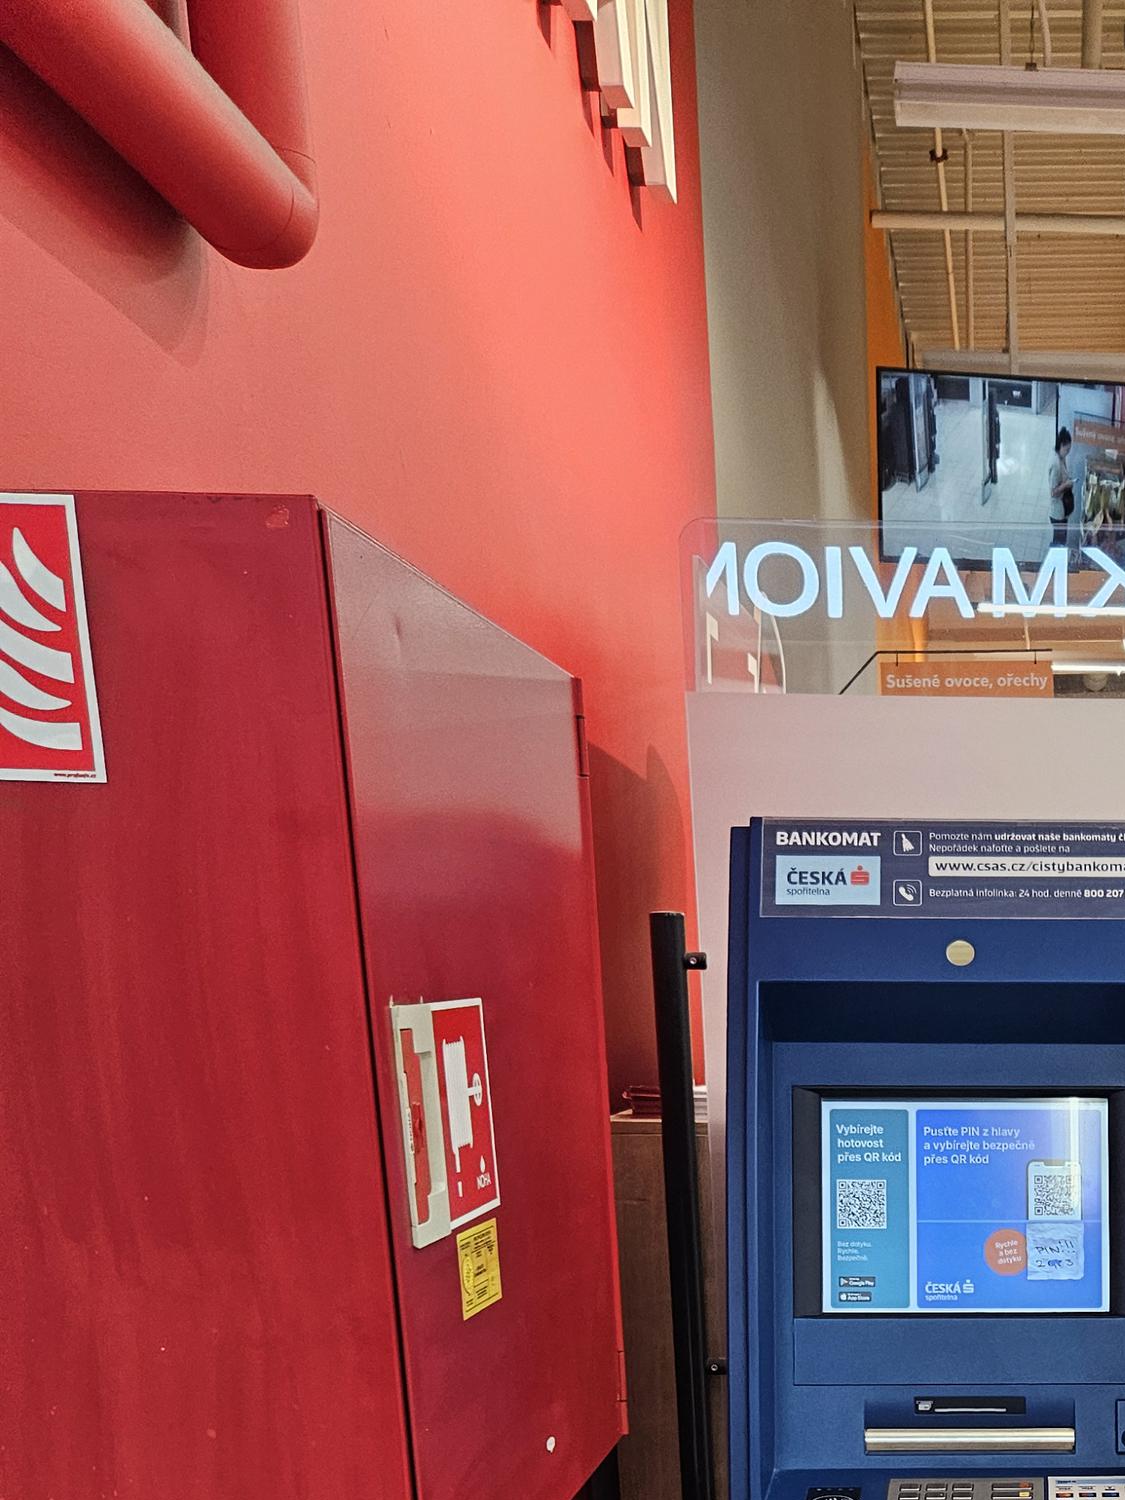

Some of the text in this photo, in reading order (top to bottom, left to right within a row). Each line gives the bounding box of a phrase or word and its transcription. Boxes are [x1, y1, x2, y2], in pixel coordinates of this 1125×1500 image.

[886, 673, 1048, 689] Sušené ovoce, ořechy
[776, 831, 881, 846] BANKOMAT
[929, 832, 970, 841] Pomozte
[971, 832, 993, 841] nám
[995, 832, 1037, 841] udržovat
[1038, 832, 1061, 841] naše
[1063, 832, 1116, 842] bankomaty
[929, 844, 978, 854] Nepořádek
[1023, 844, 1057, 854] pošlete
[786, 867, 847, 886] ČESKÁ
[786, 887, 831, 896] spořitelna
[929, 888, 974, 899] Bezplatná
[976, 888, 1017, 898] infolinka:
[1018, 889, 1030, 898] 24
[1031, 889, 1052, 898] hod.
[1053, 888, 1082, 898] denně
[1084, 889, 1104, 898] 800
[1106, 889, 1123, 898] 207
[836, 1124, 884, 1135] Vybírejte
[923, 1126, 958, 1137] Pusťte
[961, 1126, 980, 1136] PIN
[991, 1126, 1020, 1138] hlavy
[838, 1138, 884, 1148] hotovost
[923, 1140, 1035, 1152] a vybírejte bezpečně
[837, 1152, 902, 1164] přes QR kód
[923, 1154, 989, 1166] přes QR kód
[925, 1281, 961, 1294] ČESKÁ
